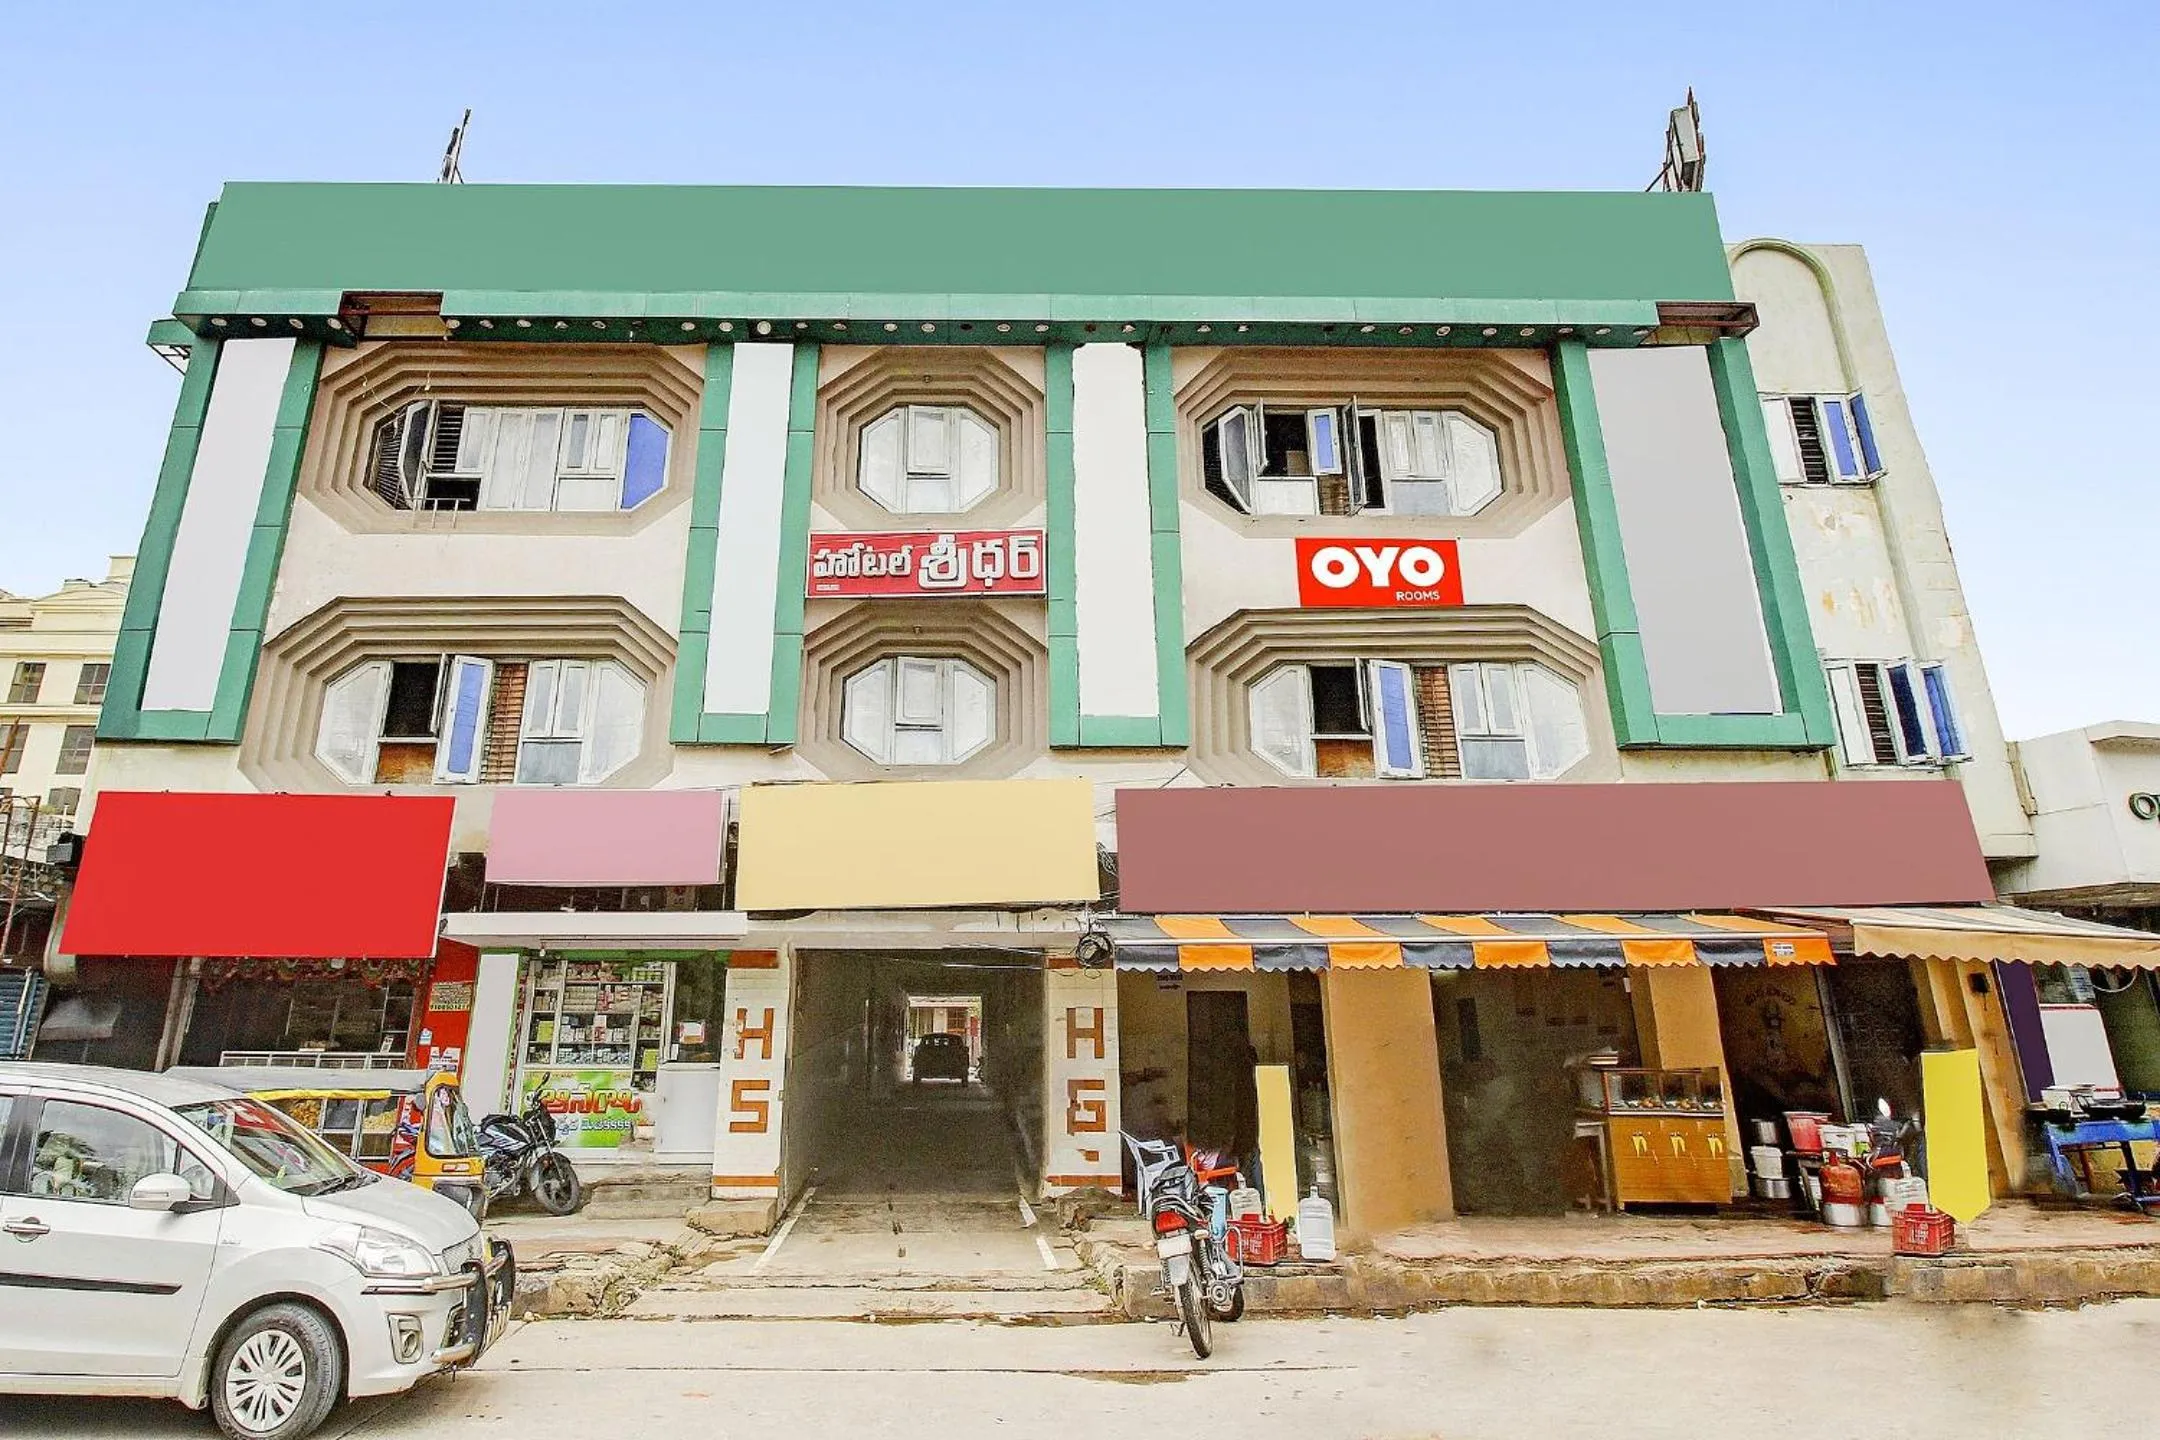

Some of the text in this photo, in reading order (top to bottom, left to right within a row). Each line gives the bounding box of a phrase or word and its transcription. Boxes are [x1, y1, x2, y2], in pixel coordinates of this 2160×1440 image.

[918, 534, 1040, 589] శ్రీధర్
[1311, 546, 1445, 588] OYO
[1395, 590, 1441, 601] ROOMS
